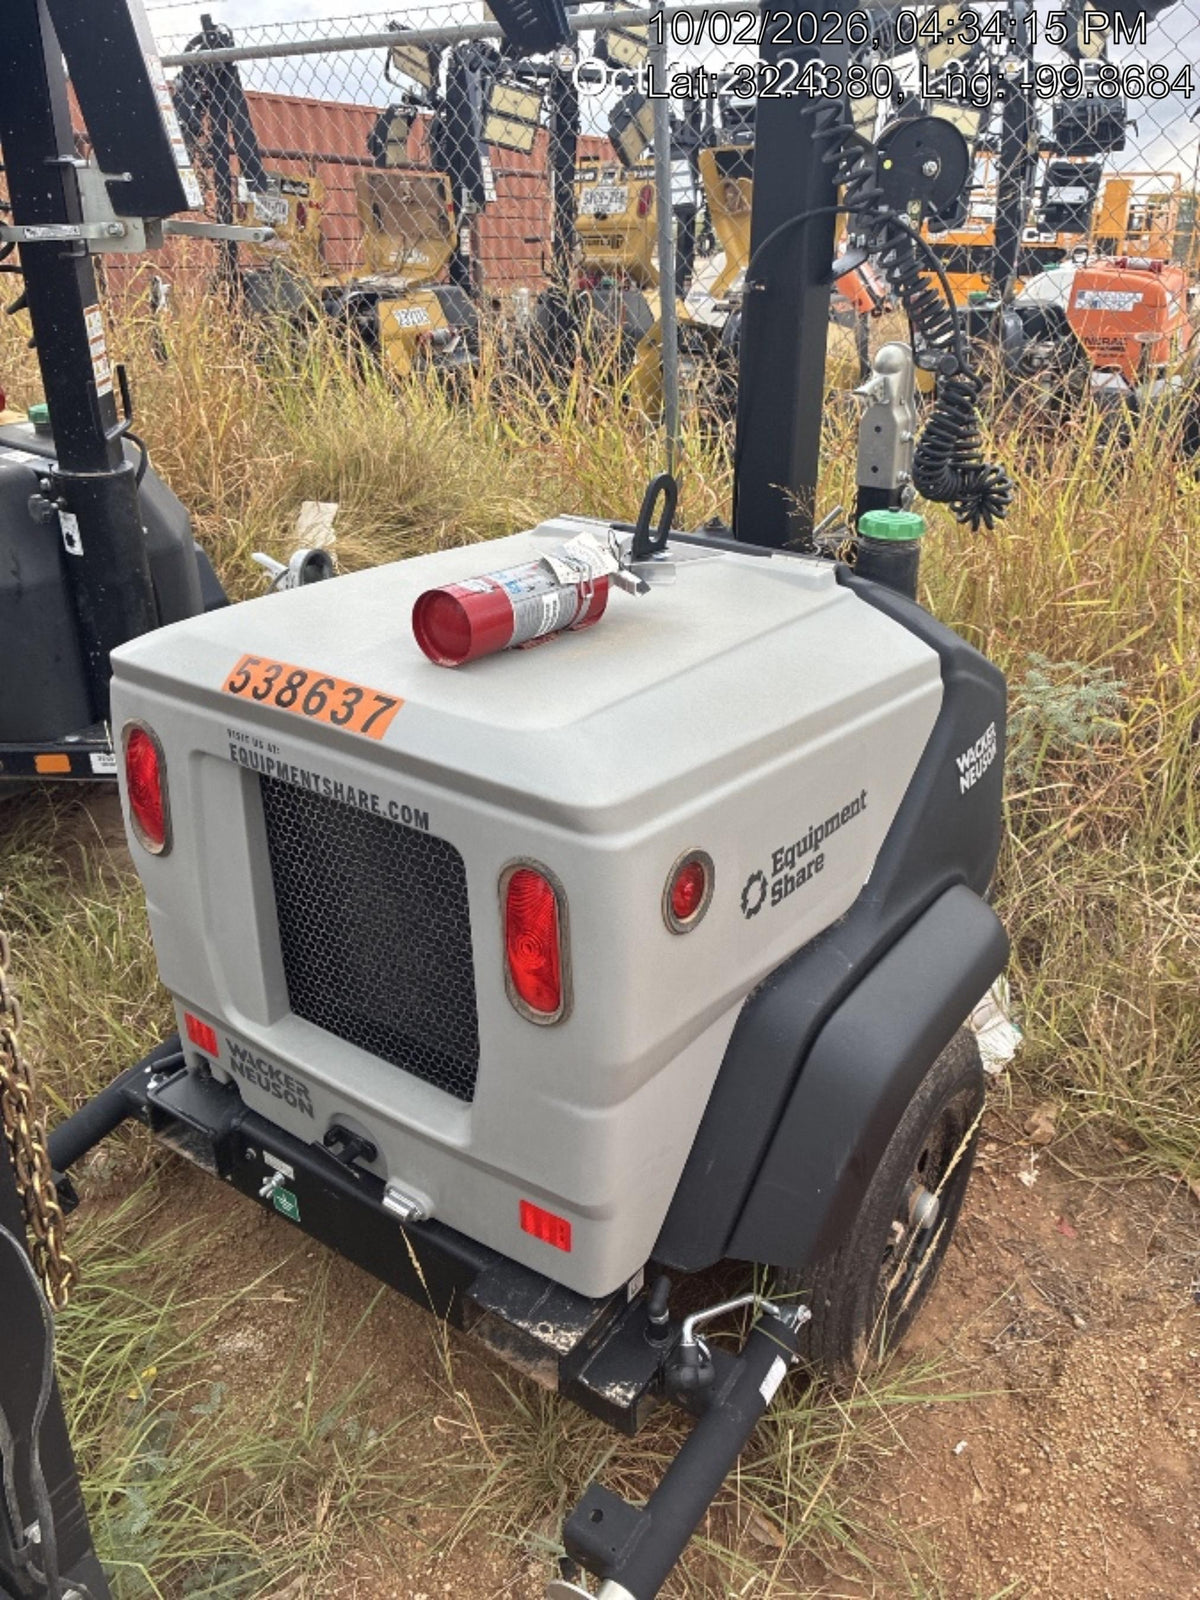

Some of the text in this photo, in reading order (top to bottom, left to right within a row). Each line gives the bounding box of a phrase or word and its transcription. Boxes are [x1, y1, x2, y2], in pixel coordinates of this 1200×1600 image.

[228, 655, 397, 734] 538637
[955, 721, 997, 773] WACKER
[959, 742, 997, 794] NEUSON
[228, 742, 431, 831] EQUIPMENTSHARE.COM
[771, 788, 868, 878] Equipment
[771, 852, 825, 908] Share
[225, 1037, 311, 1100] WACKER
[229, 1056, 316, 1120] NEUSON
